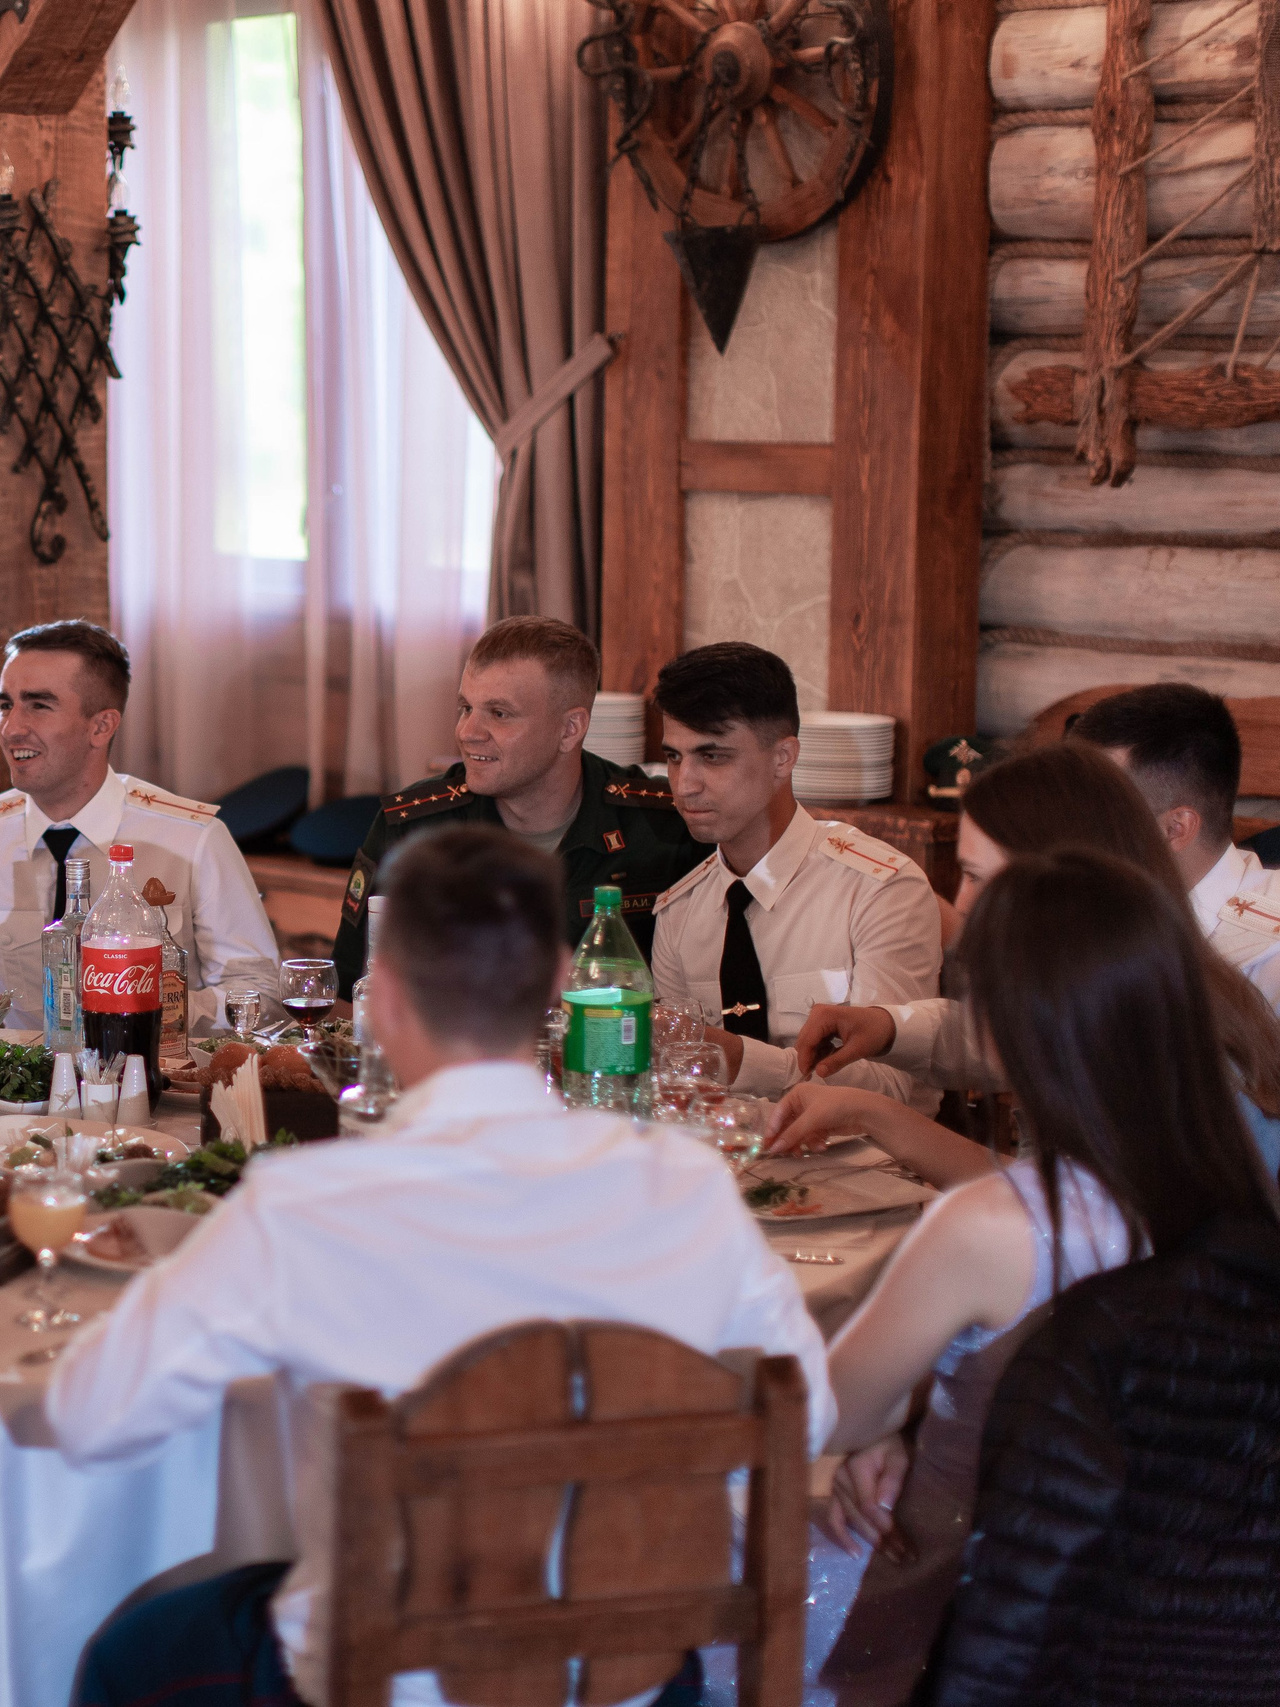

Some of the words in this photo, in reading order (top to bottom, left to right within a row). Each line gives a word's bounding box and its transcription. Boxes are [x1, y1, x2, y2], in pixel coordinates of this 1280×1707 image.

[83, 964, 157, 995] Coca-Cola
[162, 990, 185, 1003] ERRA
[162, 1004, 179, 1012] EQUILA
